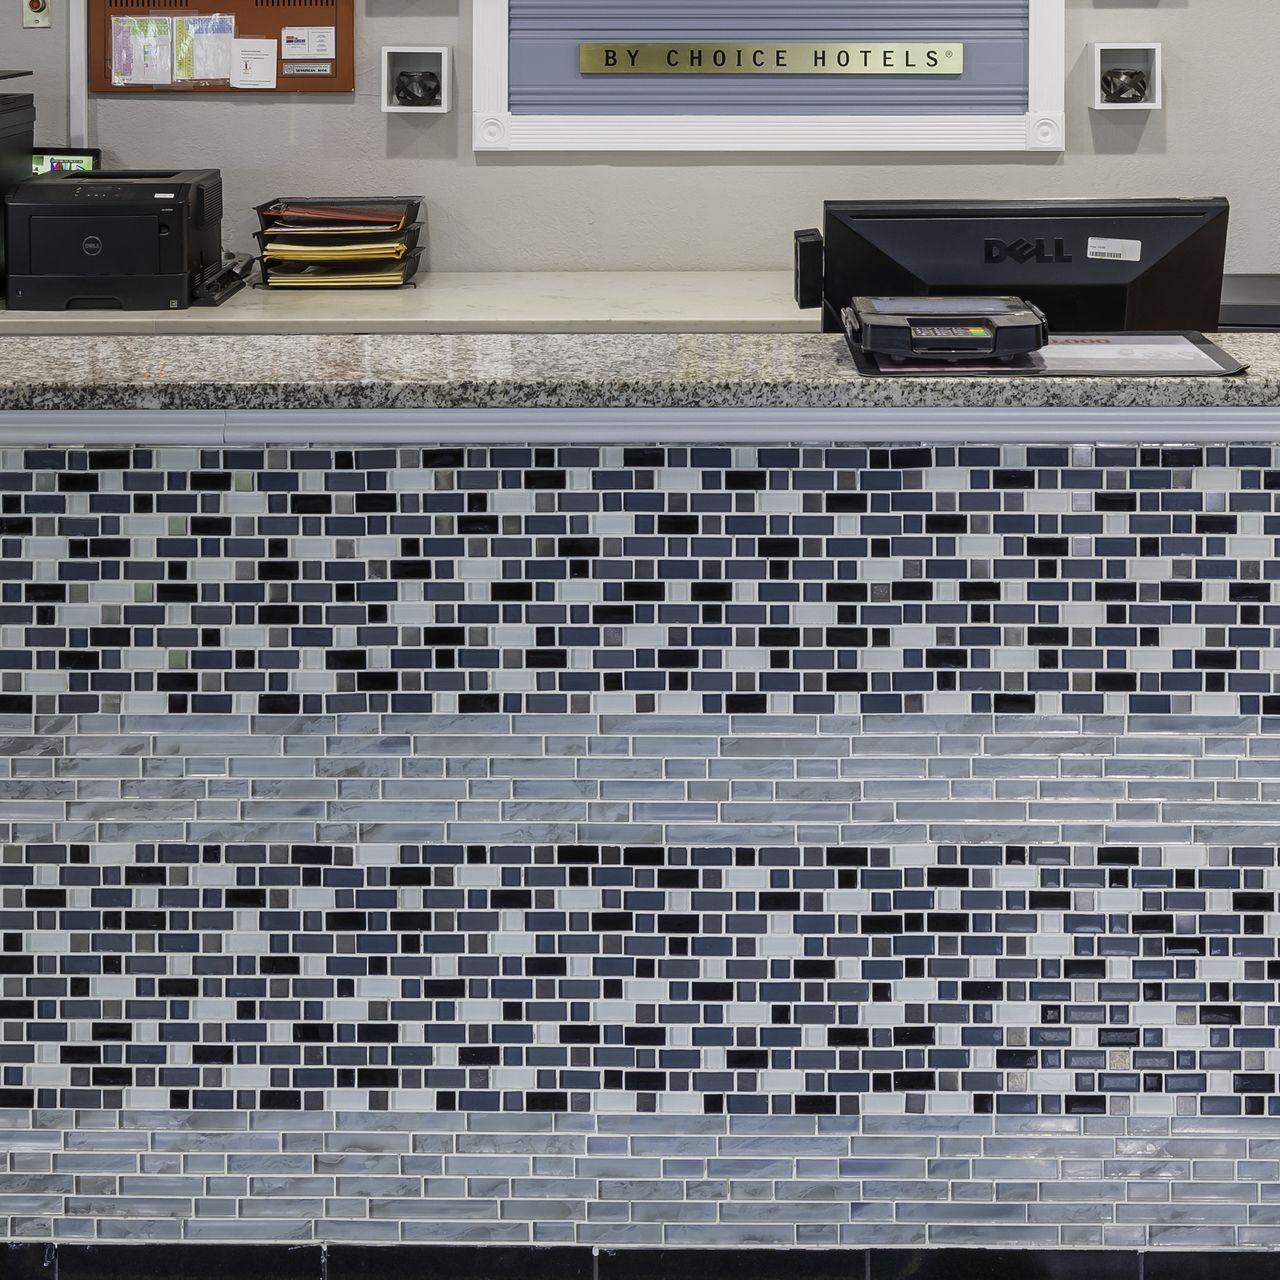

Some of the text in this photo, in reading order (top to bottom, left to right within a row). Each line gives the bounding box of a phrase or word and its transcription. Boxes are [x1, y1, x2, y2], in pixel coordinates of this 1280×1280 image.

[604, 49, 640, 68] BY
[666, 49, 788, 68] CHOICE
[984, 236, 1072, 264] DELL
